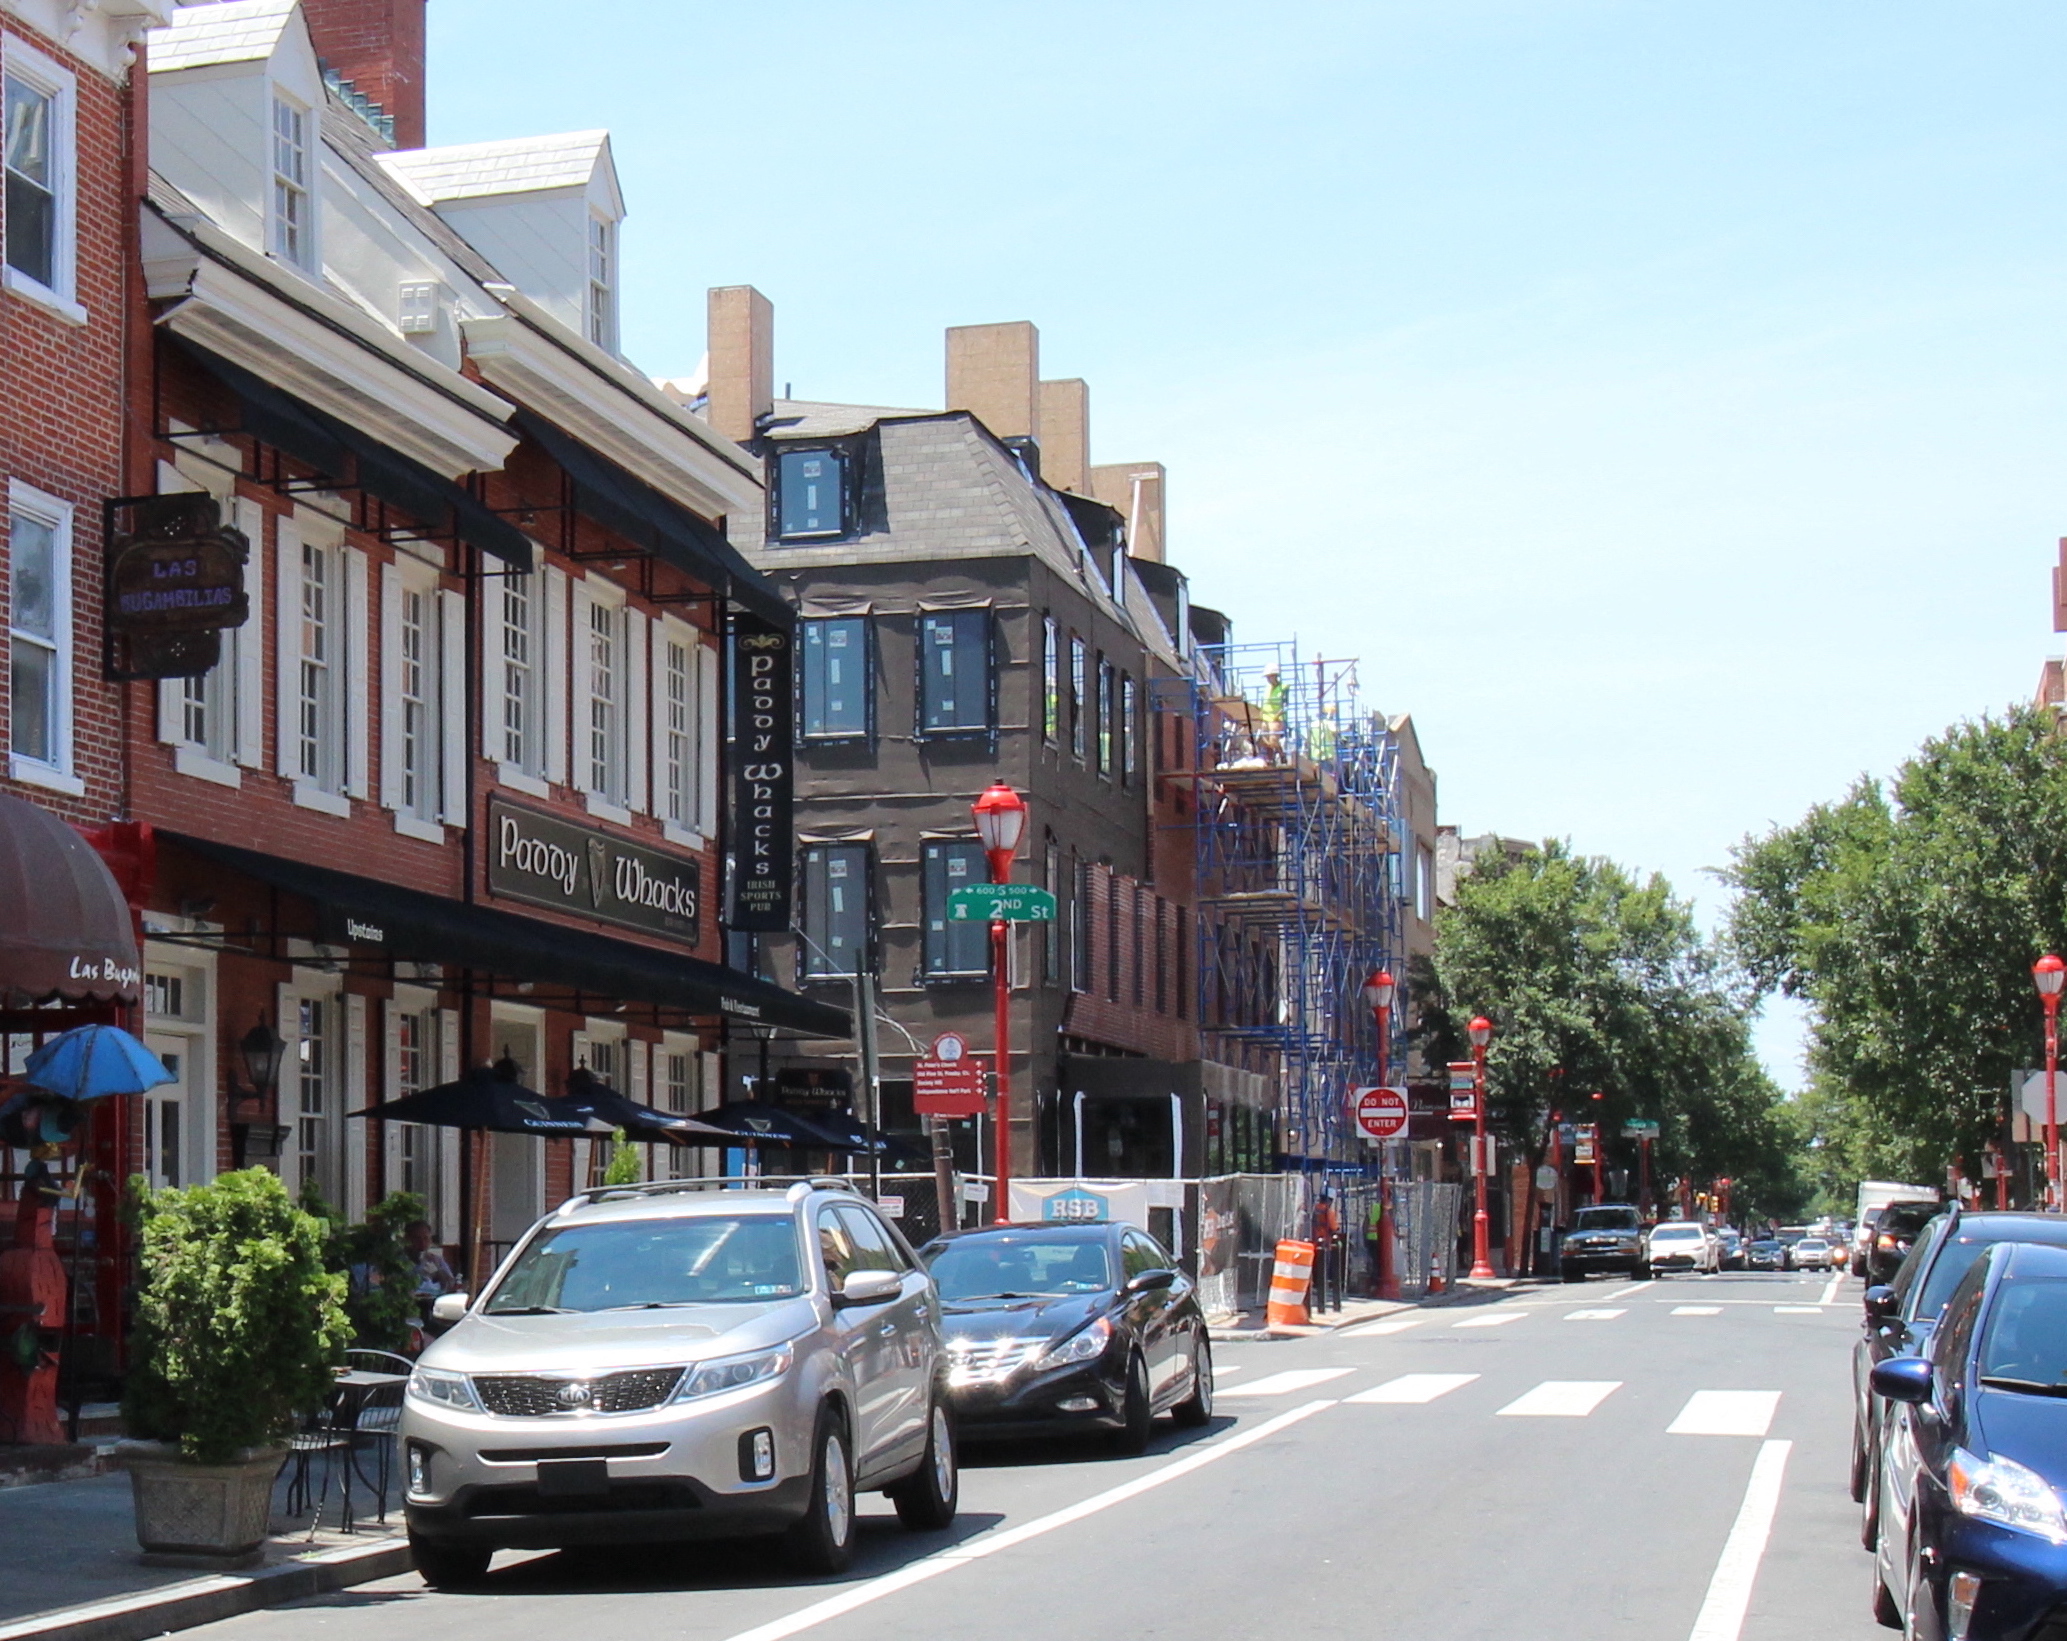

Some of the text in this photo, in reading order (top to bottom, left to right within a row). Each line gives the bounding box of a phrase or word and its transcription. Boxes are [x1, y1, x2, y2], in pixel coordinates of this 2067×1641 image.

[153, 560, 197, 578] LAS
[501, 815, 579, 895] Paddy
[616, 856, 695, 918] Whacks
[747, 880, 776, 889] IRISH
[741, 890, 781, 900] SPORTS
[976, 885, 1027, 896] 600 S 500
[750, 902, 771, 912] PUB
[1031, 905, 1049, 919] St
[70, 956, 99, 979] Las
[1364, 1098, 1399, 1106] DO NOT
[1367, 1119, 1397, 1128] ENTER
[560, 1390, 584, 1401] KIA
